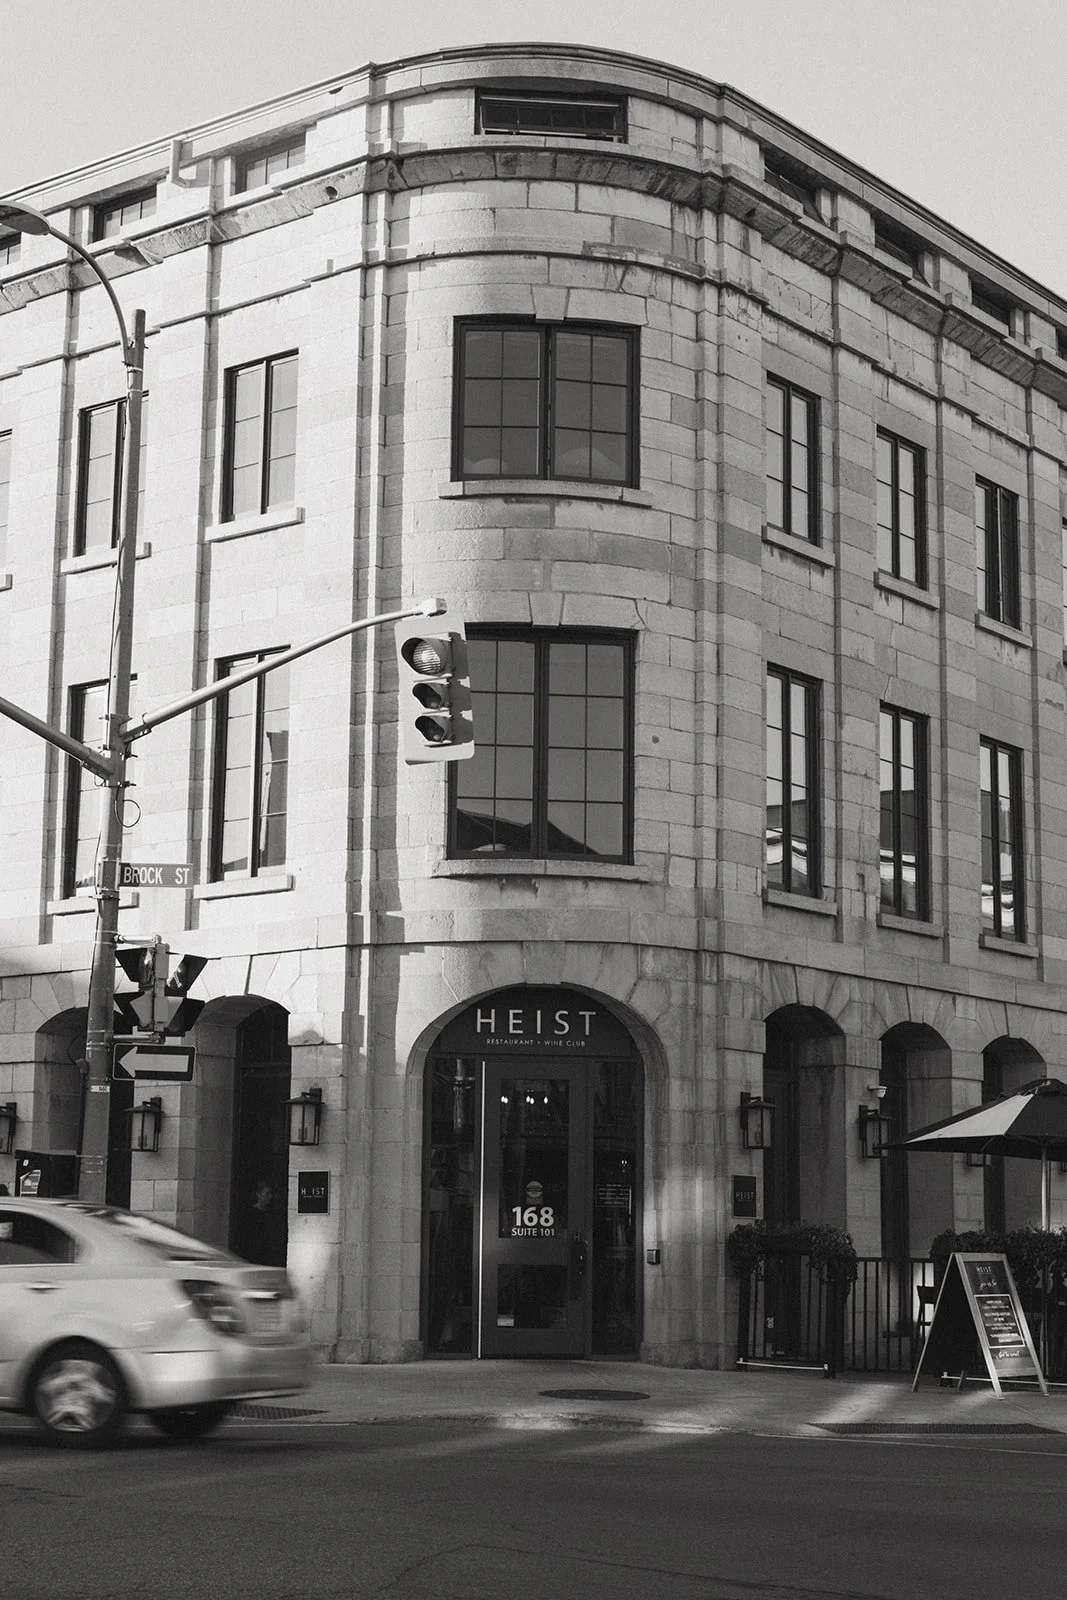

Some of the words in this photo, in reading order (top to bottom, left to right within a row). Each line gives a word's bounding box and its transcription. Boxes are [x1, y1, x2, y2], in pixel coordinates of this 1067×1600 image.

[123, 866, 163, 884] BROCK
[175, 867, 190, 885] ST
[476, 1008, 596, 1035] HEIST
[486, 1038, 534, 1046] RESTAURANT
[511, 1206, 555, 1227] 168
[511, 1227, 538, 1237] SUITE
[540, 1228, 555, 1237] 101
